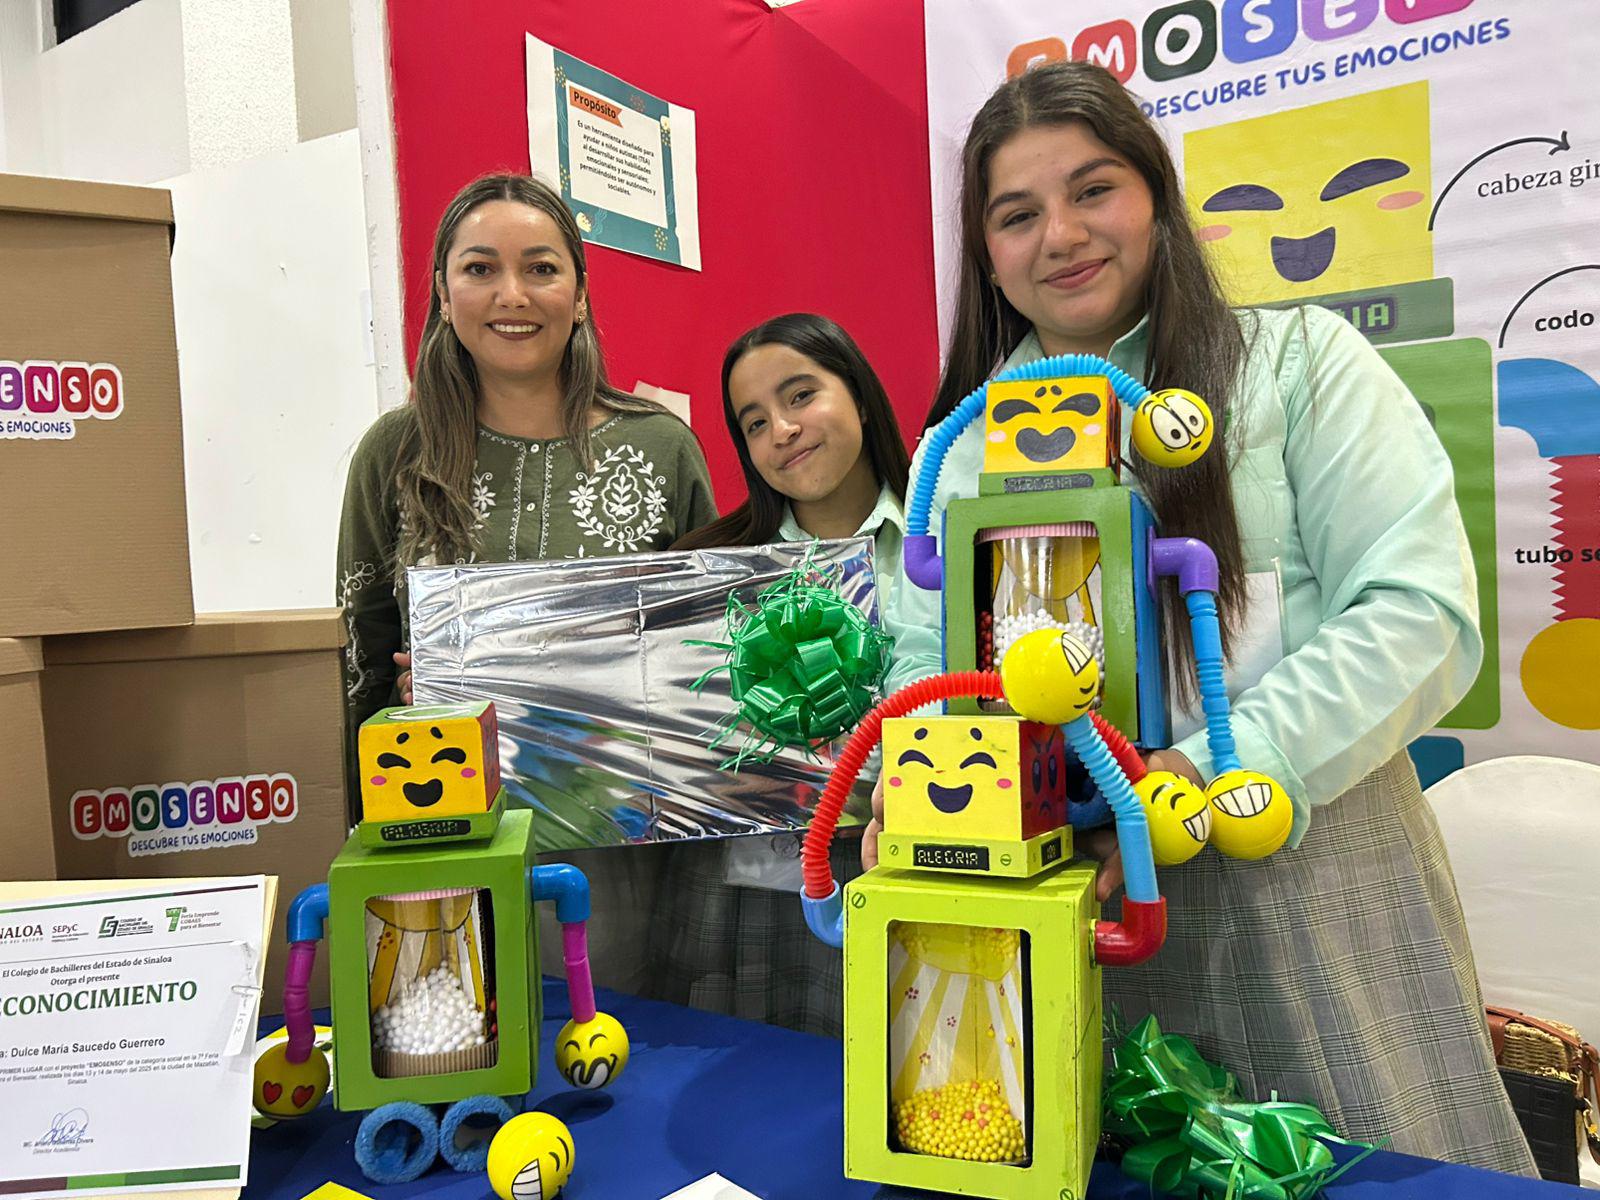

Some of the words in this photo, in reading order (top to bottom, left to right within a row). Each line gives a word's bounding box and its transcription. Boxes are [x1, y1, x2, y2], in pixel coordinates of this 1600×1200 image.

[1276, 61, 1327, 90] TUS
[1335, 17, 1511, 77] EMOCIONES
[573, 90, 617, 119] Propósito
[1478, 168, 1562, 198] cabeza
[1534, 309, 1595, 332] codo
[7, 420, 72, 434] EMOCIONES
[1514, 545, 1574, 564] tubo
[82, 787, 290, 829] EMOSENSO
[131, 836, 179, 852] DESCUBRE
[181, 834, 199, 846] TUS
[201, 828, 255, 845] EMOCIONES
[917, 849, 979, 866] ALEGRIA
[2, 970, 10, 978] El
[10, 967, 39, 978] Colegio
[40, 966, 49, 975] de
[50, 963, 92, 974] Bachilleres
[93, 960, 104, 969] del
[105, 957, 132, 969] Estado
[132, 957, 143, 966] de
[143, 955, 172, 965] Sinaloa
[50, 976, 77, 986] Otorga
[78, 975, 85, 983] el
[86, 973, 120, 985] presente
[0, 980, 197, 1017] CONOCIMIENTO
[11, 1046, 39, 1058] Dulce
[42, 1043, 69, 1055] María
[72, 1040, 116, 1053] Saucedo
[119, 1038, 165, 1050] Guerrero
[23, 1065, 43, 1073] LUGAR
